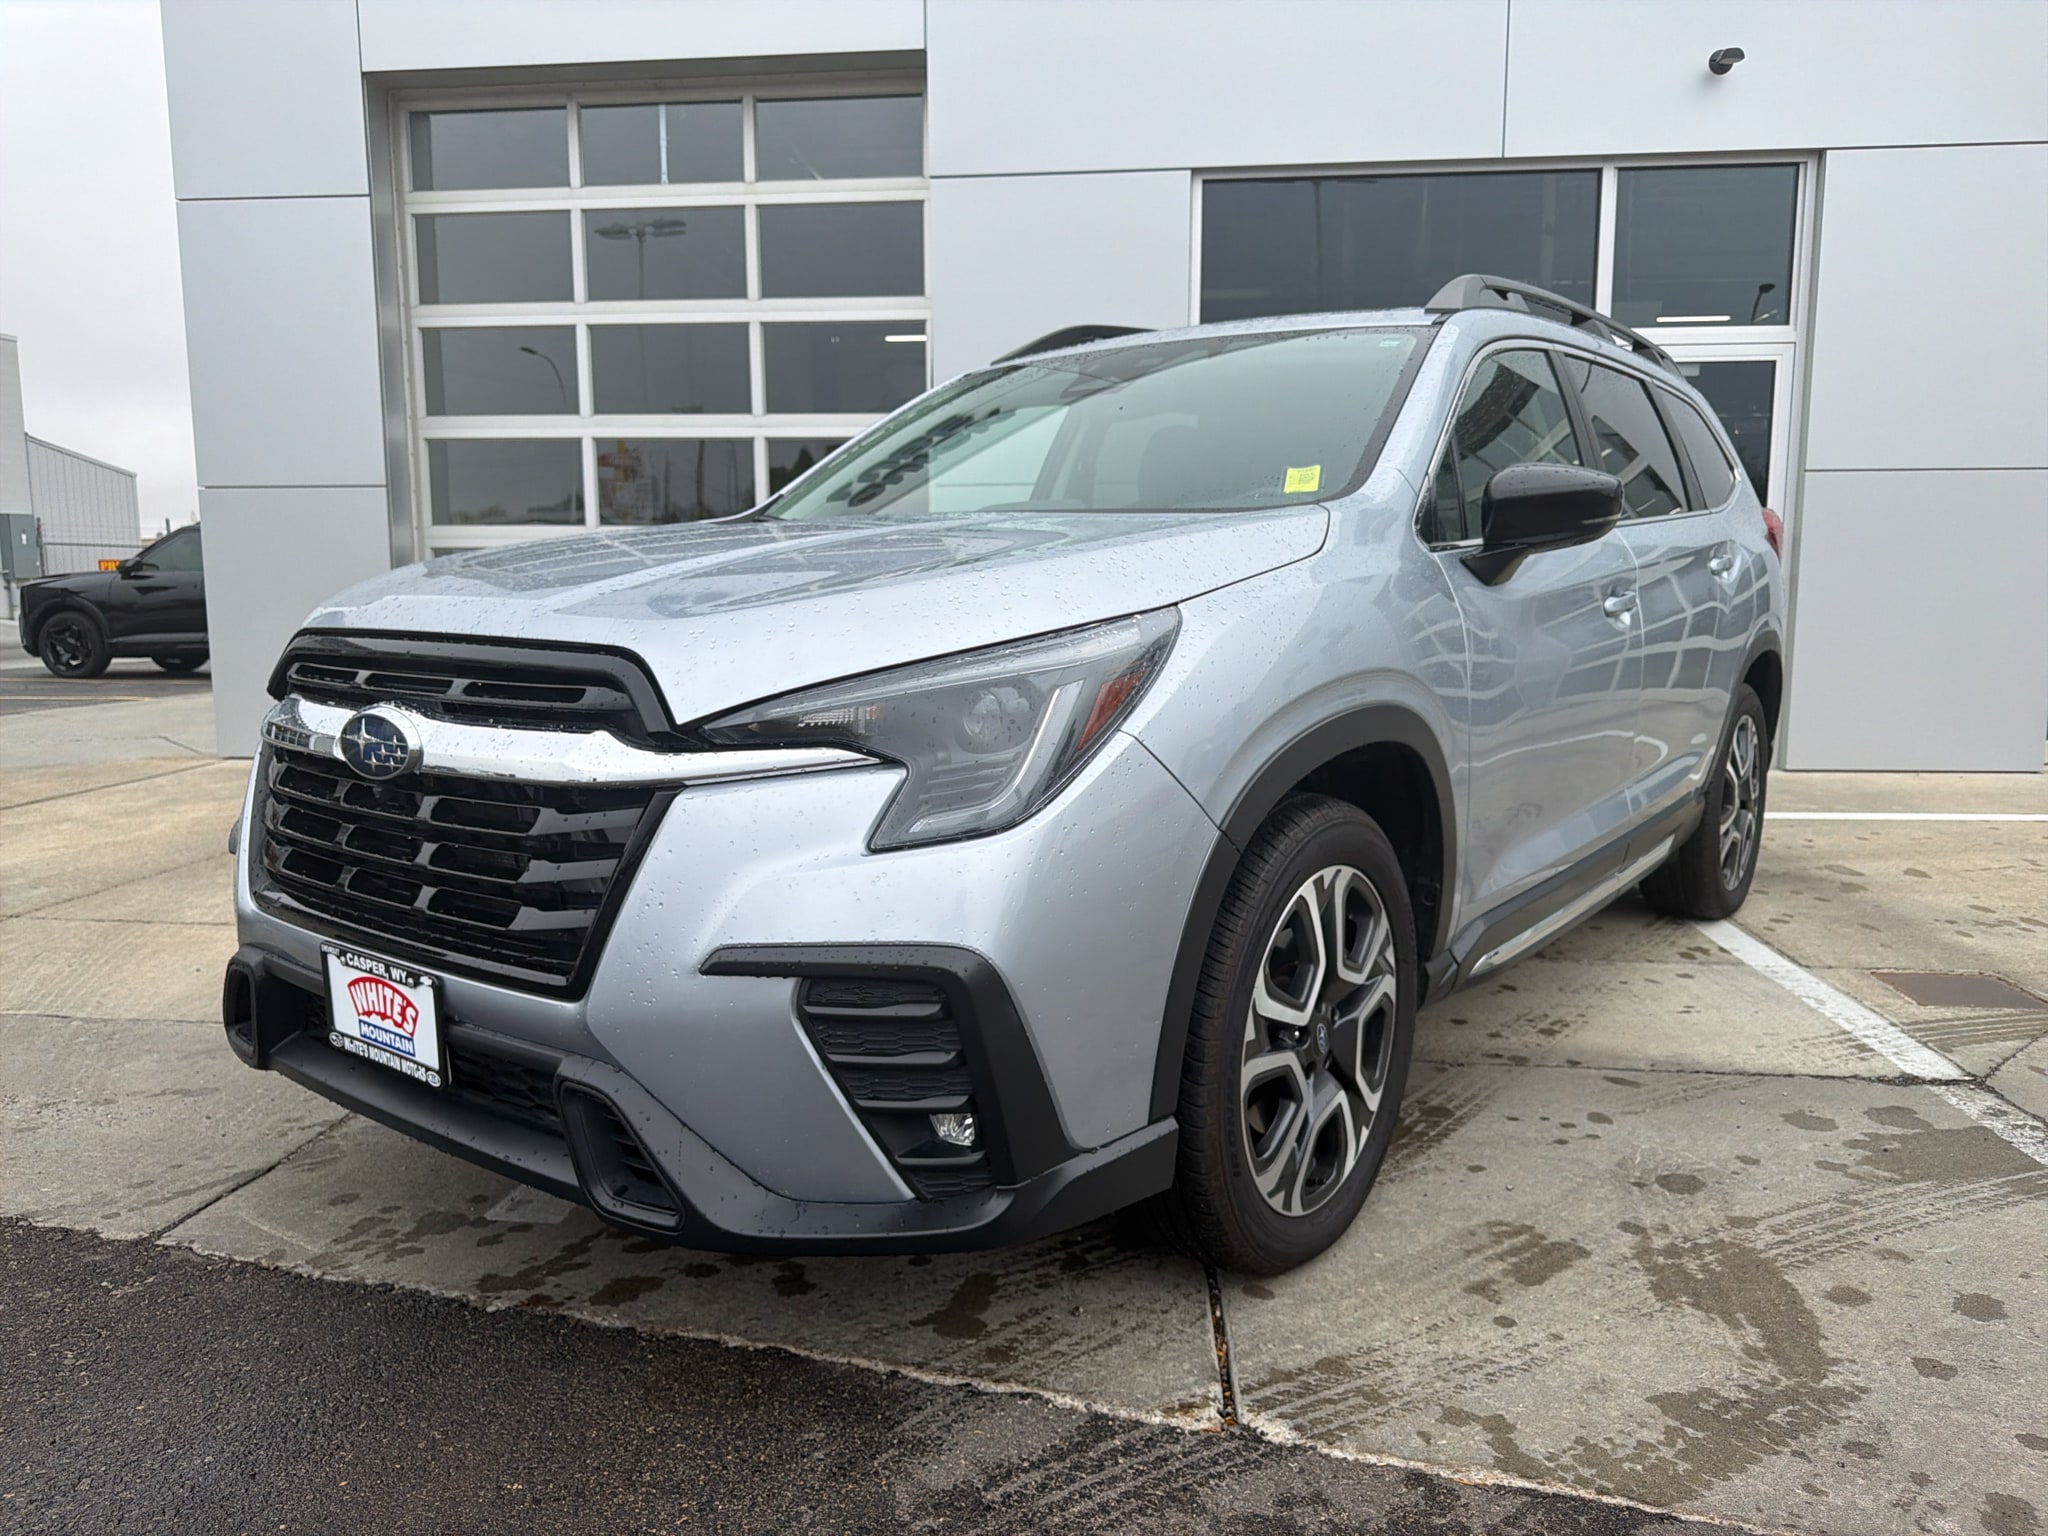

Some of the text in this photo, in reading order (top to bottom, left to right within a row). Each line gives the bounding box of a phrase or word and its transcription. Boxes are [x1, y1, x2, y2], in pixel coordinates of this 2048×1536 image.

[346, 953, 408, 983] CASPER, WY
[350, 981, 417, 1034] WHITE'S
[361, 1022, 414, 1054] MOUNTAIN
[369, 1045, 401, 1072] MOUNTAIN
